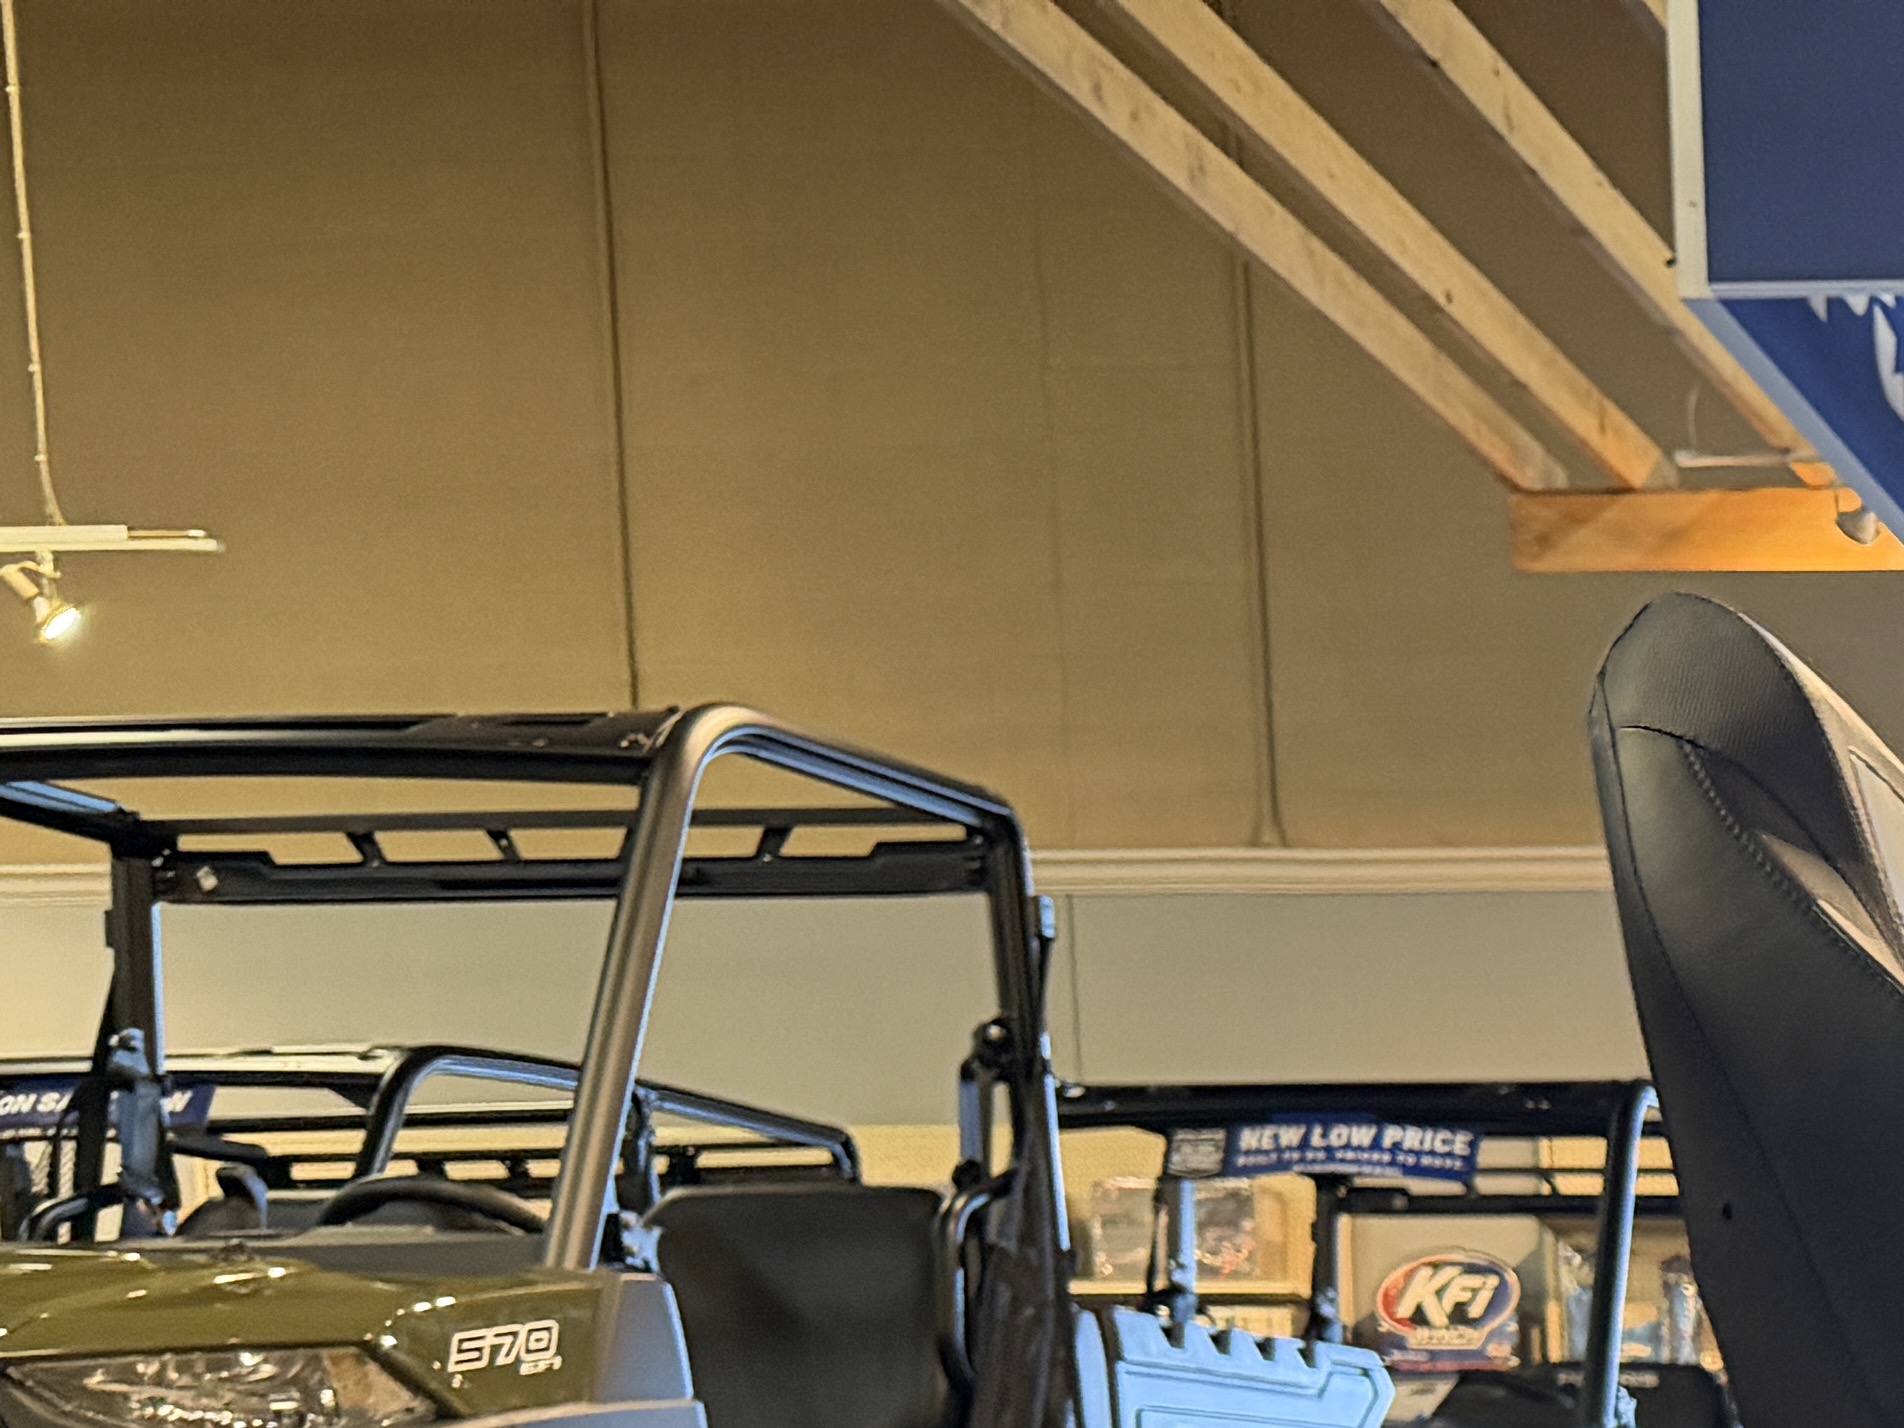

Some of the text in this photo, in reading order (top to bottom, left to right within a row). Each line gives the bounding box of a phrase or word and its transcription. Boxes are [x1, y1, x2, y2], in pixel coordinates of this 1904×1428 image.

[1239, 1123, 1475, 1156] NEW LOW PRICE
[447, 1319, 559, 1373] 570
